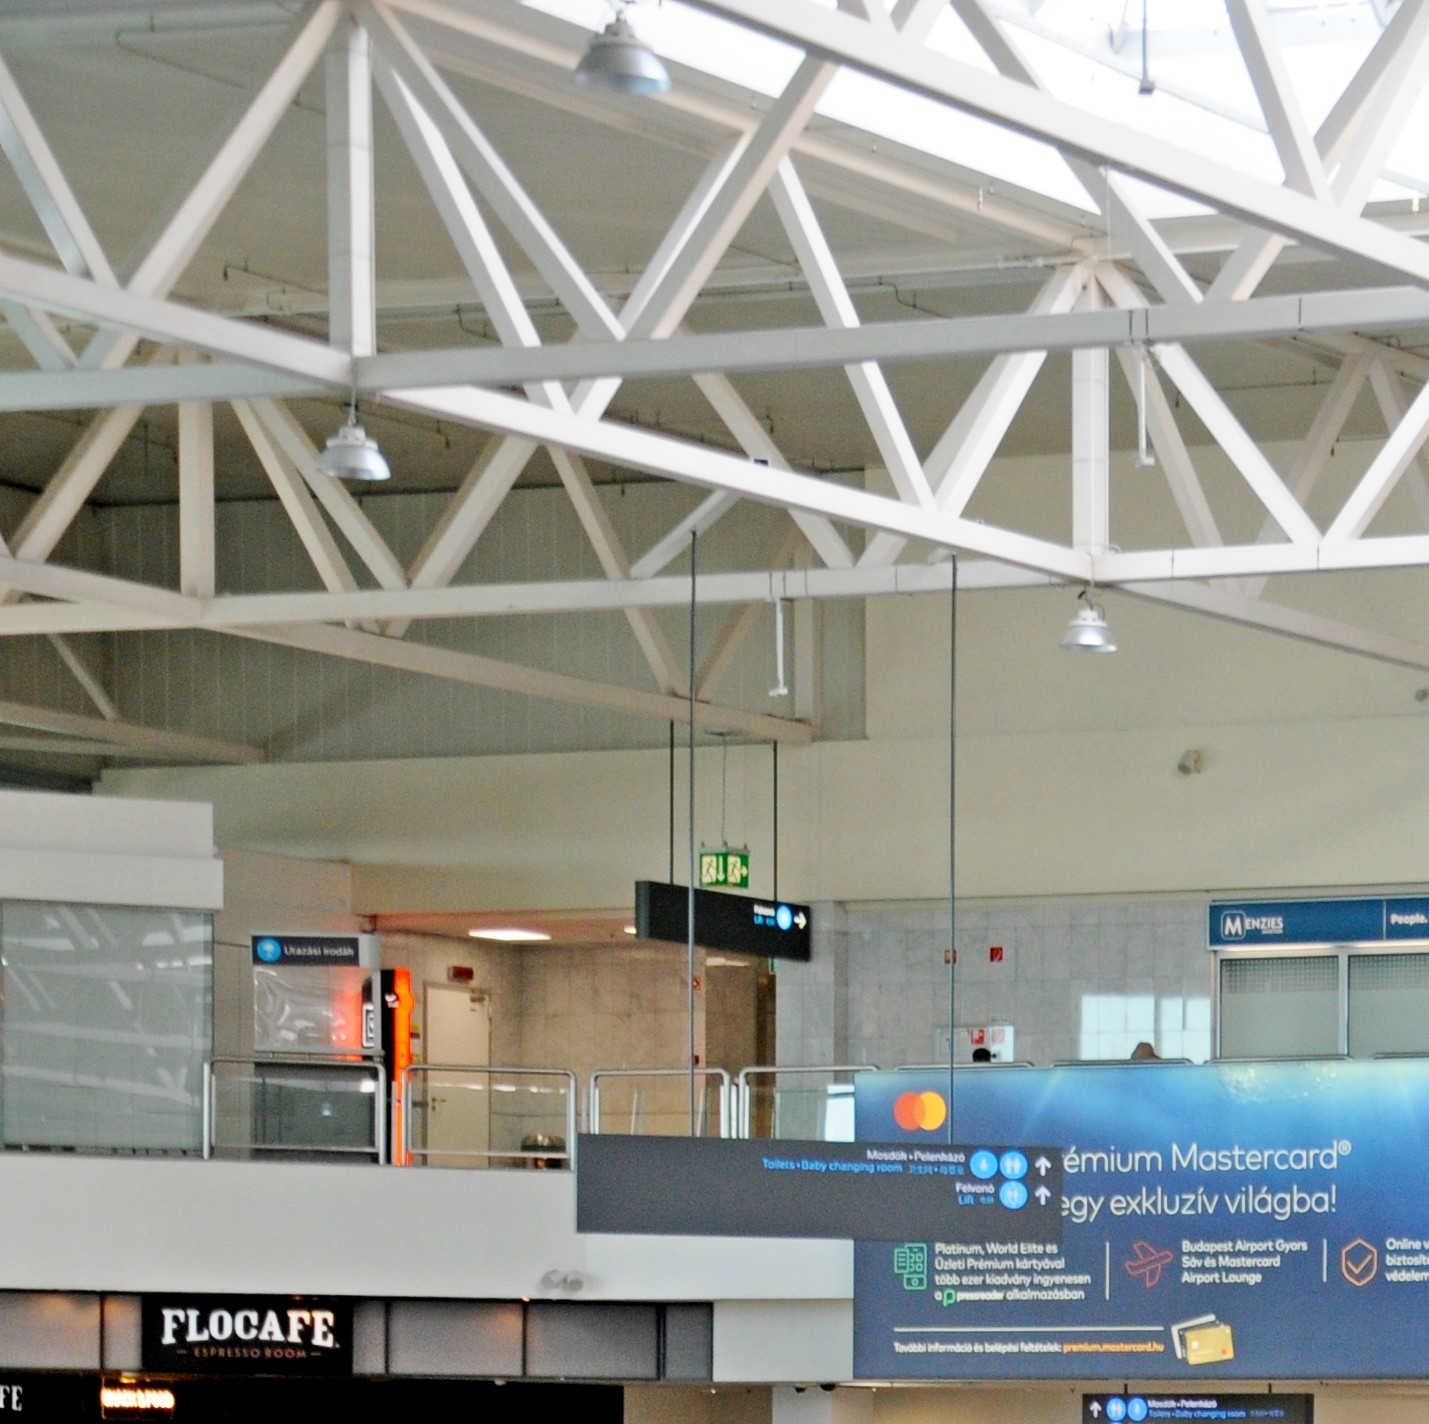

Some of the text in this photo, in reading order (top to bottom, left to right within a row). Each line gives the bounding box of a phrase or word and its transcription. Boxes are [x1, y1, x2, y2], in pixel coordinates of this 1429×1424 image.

[1390, 912, 1428, 926] People.
[1224, 916, 1283, 936] MENZIES
[1062, 1145, 1163, 1173] émium
[828, 1161, 874, 1174] changing
[876, 1164, 902, 1173] room
[955, 1183, 995, 1194] Felvonó
[1110, 1186, 1218, 1215] exkluzív
[1224, 1184, 1336, 1221] világba!
[935, 1243, 984, 1255] Platinum,
[986, 1243, 1013, 1254] World
[1016, 1243, 1041, 1254] Elite
[1182, 1239, 1308, 1253] Budapest Airport Gyors
[1386, 1238, 1421, 1250] Online
[934, 1255, 1065, 1271] Üzleti Prémium kártyával
[1182, 1256, 1280, 1268] Sáv és Mastercard
[934, 1273, 1091, 1287] több ezer kiadvány ingyenesen
[1182, 1272, 1262, 1285] Airport Lounge
[1006, 1290, 1085, 1301] alkalmazásban
[161, 1307, 335, 1349] FLOCAFE
[194, 1347, 307, 1359] ESPRESSO ROOM
